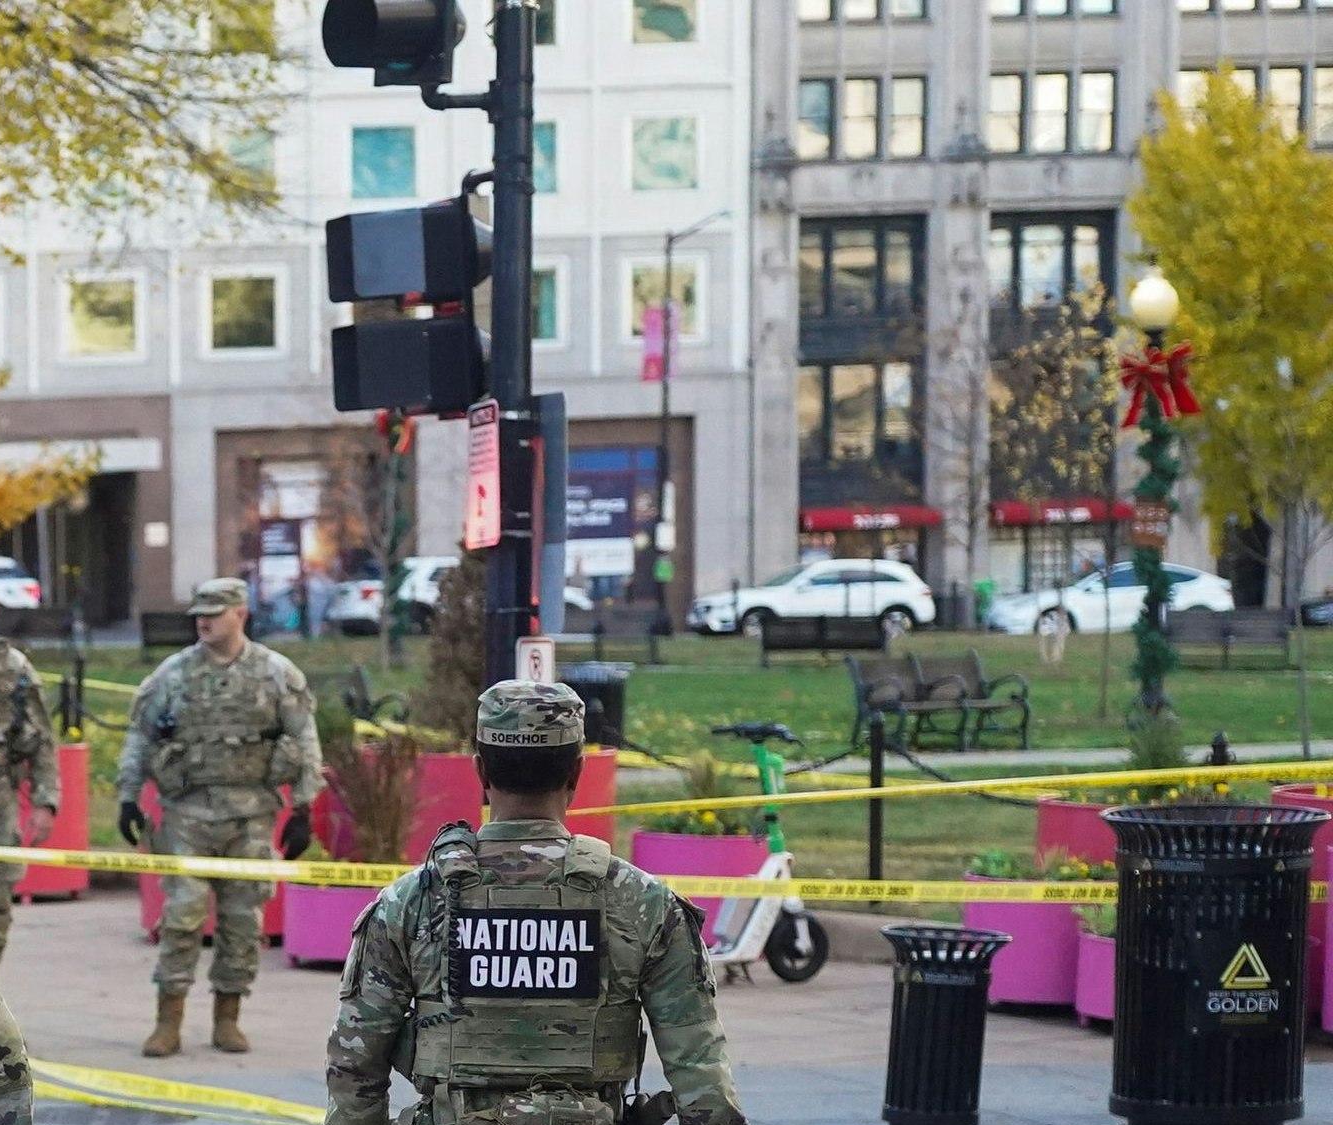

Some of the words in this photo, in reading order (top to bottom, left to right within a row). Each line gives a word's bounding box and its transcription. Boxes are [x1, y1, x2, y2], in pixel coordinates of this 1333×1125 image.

[491, 732, 548, 744] SOEKHOE
[457, 917, 595, 952] NATIONAL
[469, 954, 578, 989] GUARD
[1207, 997, 1279, 1013] GOLDEN
